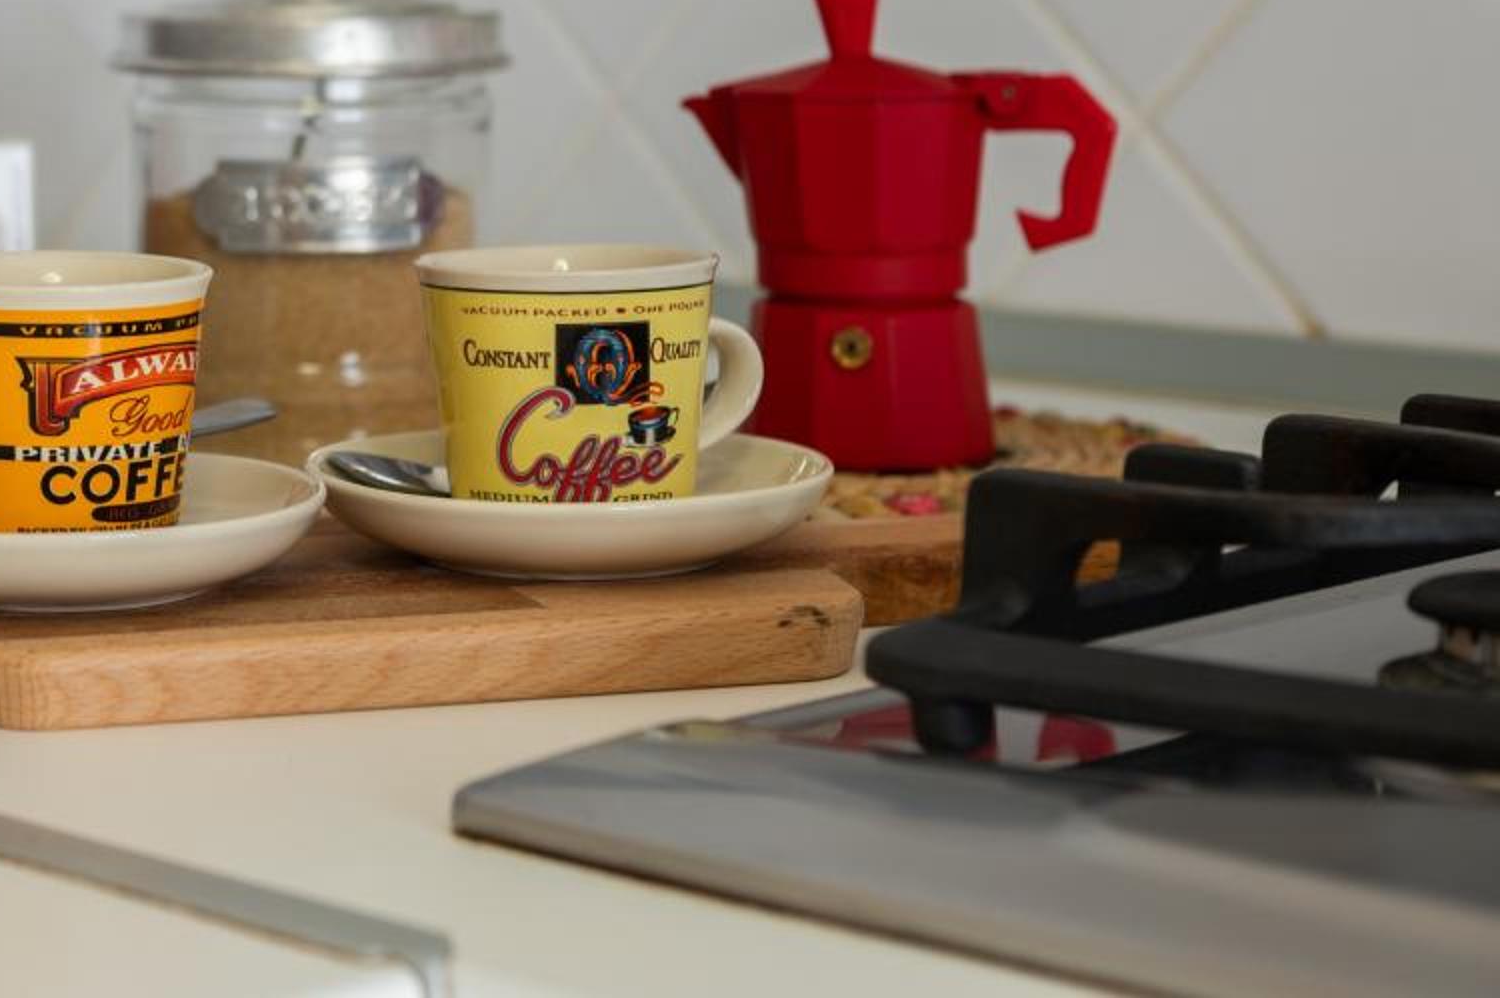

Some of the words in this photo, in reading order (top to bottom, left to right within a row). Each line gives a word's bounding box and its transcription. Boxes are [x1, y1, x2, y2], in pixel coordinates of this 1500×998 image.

[532, 306, 608, 317] PACKED
[633, 305, 663, 315] ONE
[19, 322, 163, 336] VACUUM
[109, 391, 191, 438] Good
[14, 440, 162, 463] PRIVATE
[496, 386, 684, 502] Coffee
[469, 489, 549, 503] MEDIUM
